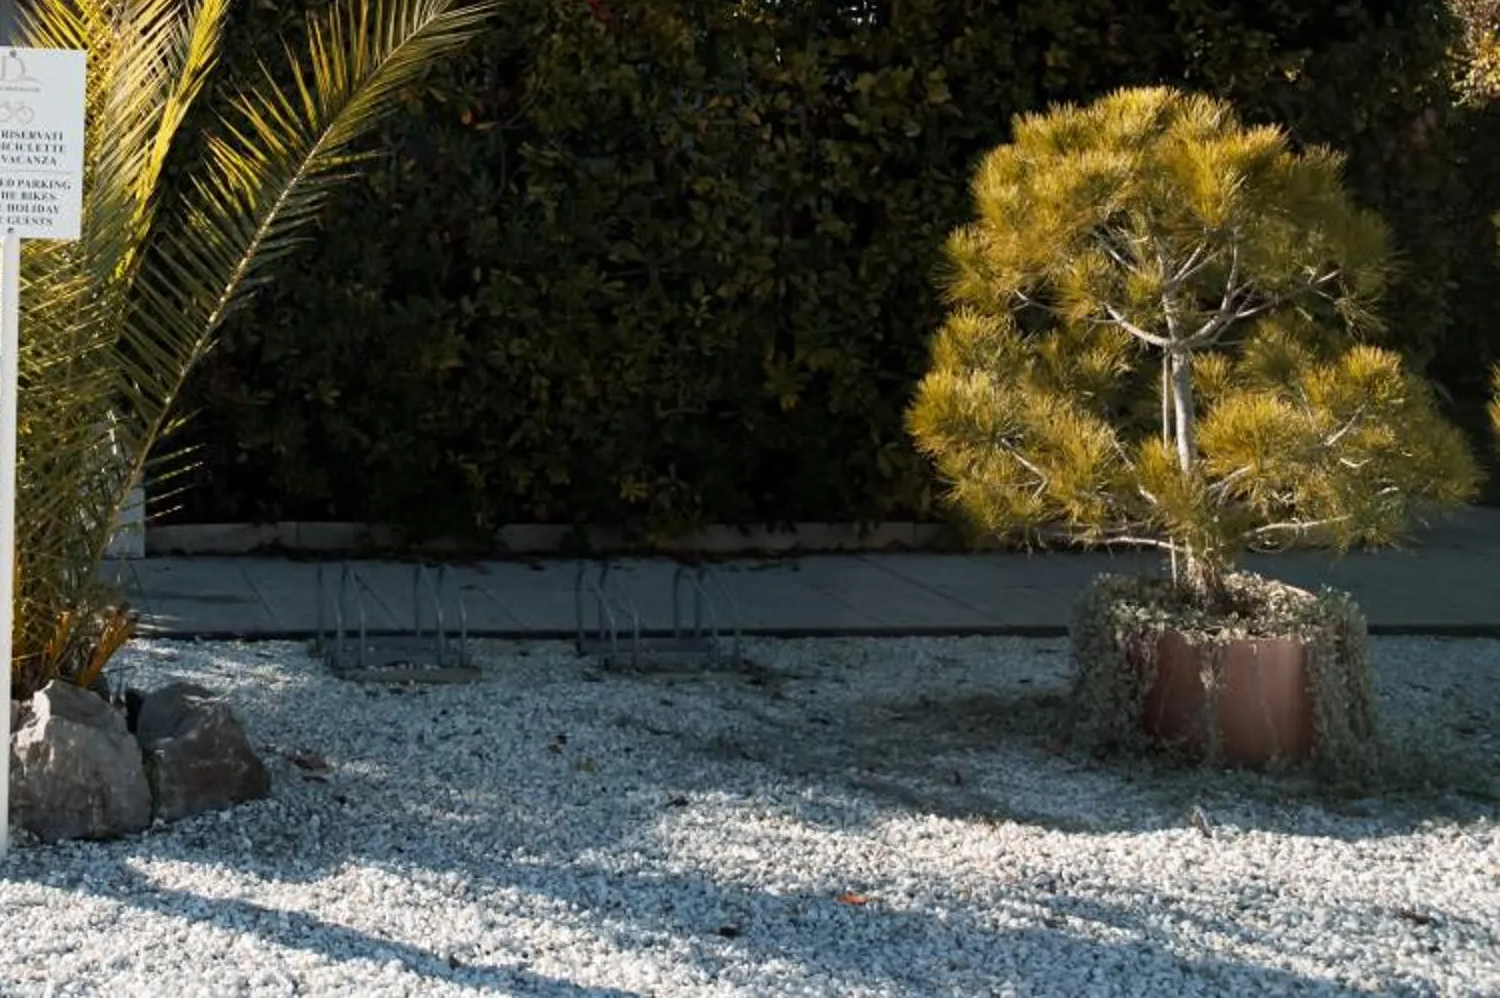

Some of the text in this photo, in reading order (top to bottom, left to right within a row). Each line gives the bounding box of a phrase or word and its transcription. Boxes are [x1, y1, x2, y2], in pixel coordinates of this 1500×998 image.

[1, 129, 63, 141] RISERVATI
[1, 154, 57, 166] VACANZA
[17, 179, 71, 190] PARKING
[21, 191, 57, 201] BIKES
[7, 203, 60, 214] HOLIDAY
[7, 215, 53, 225] GUESTS
